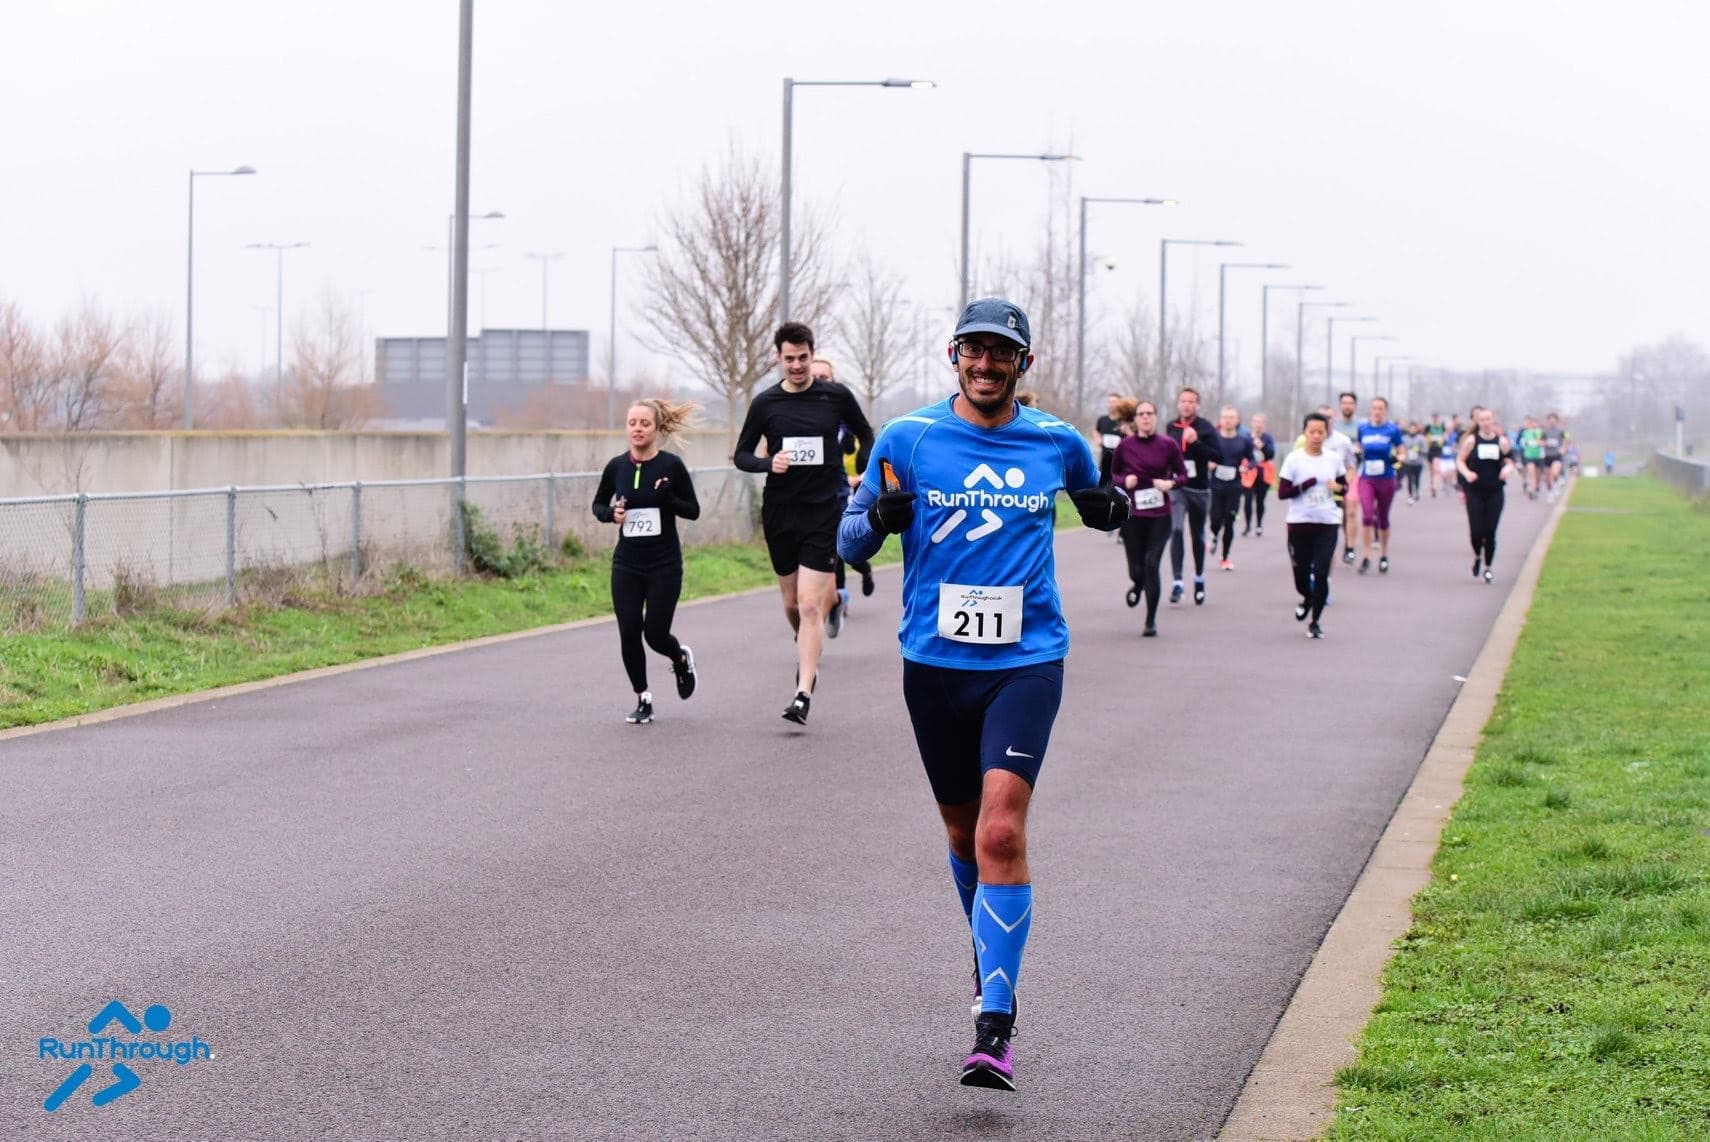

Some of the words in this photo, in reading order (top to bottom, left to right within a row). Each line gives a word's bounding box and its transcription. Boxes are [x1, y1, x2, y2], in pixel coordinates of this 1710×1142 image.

[790, 449, 816, 463] 329
[927, 491, 1049, 513] RunThrough
[628, 520, 653, 534] 792
[953, 610, 1003, 638] 211
